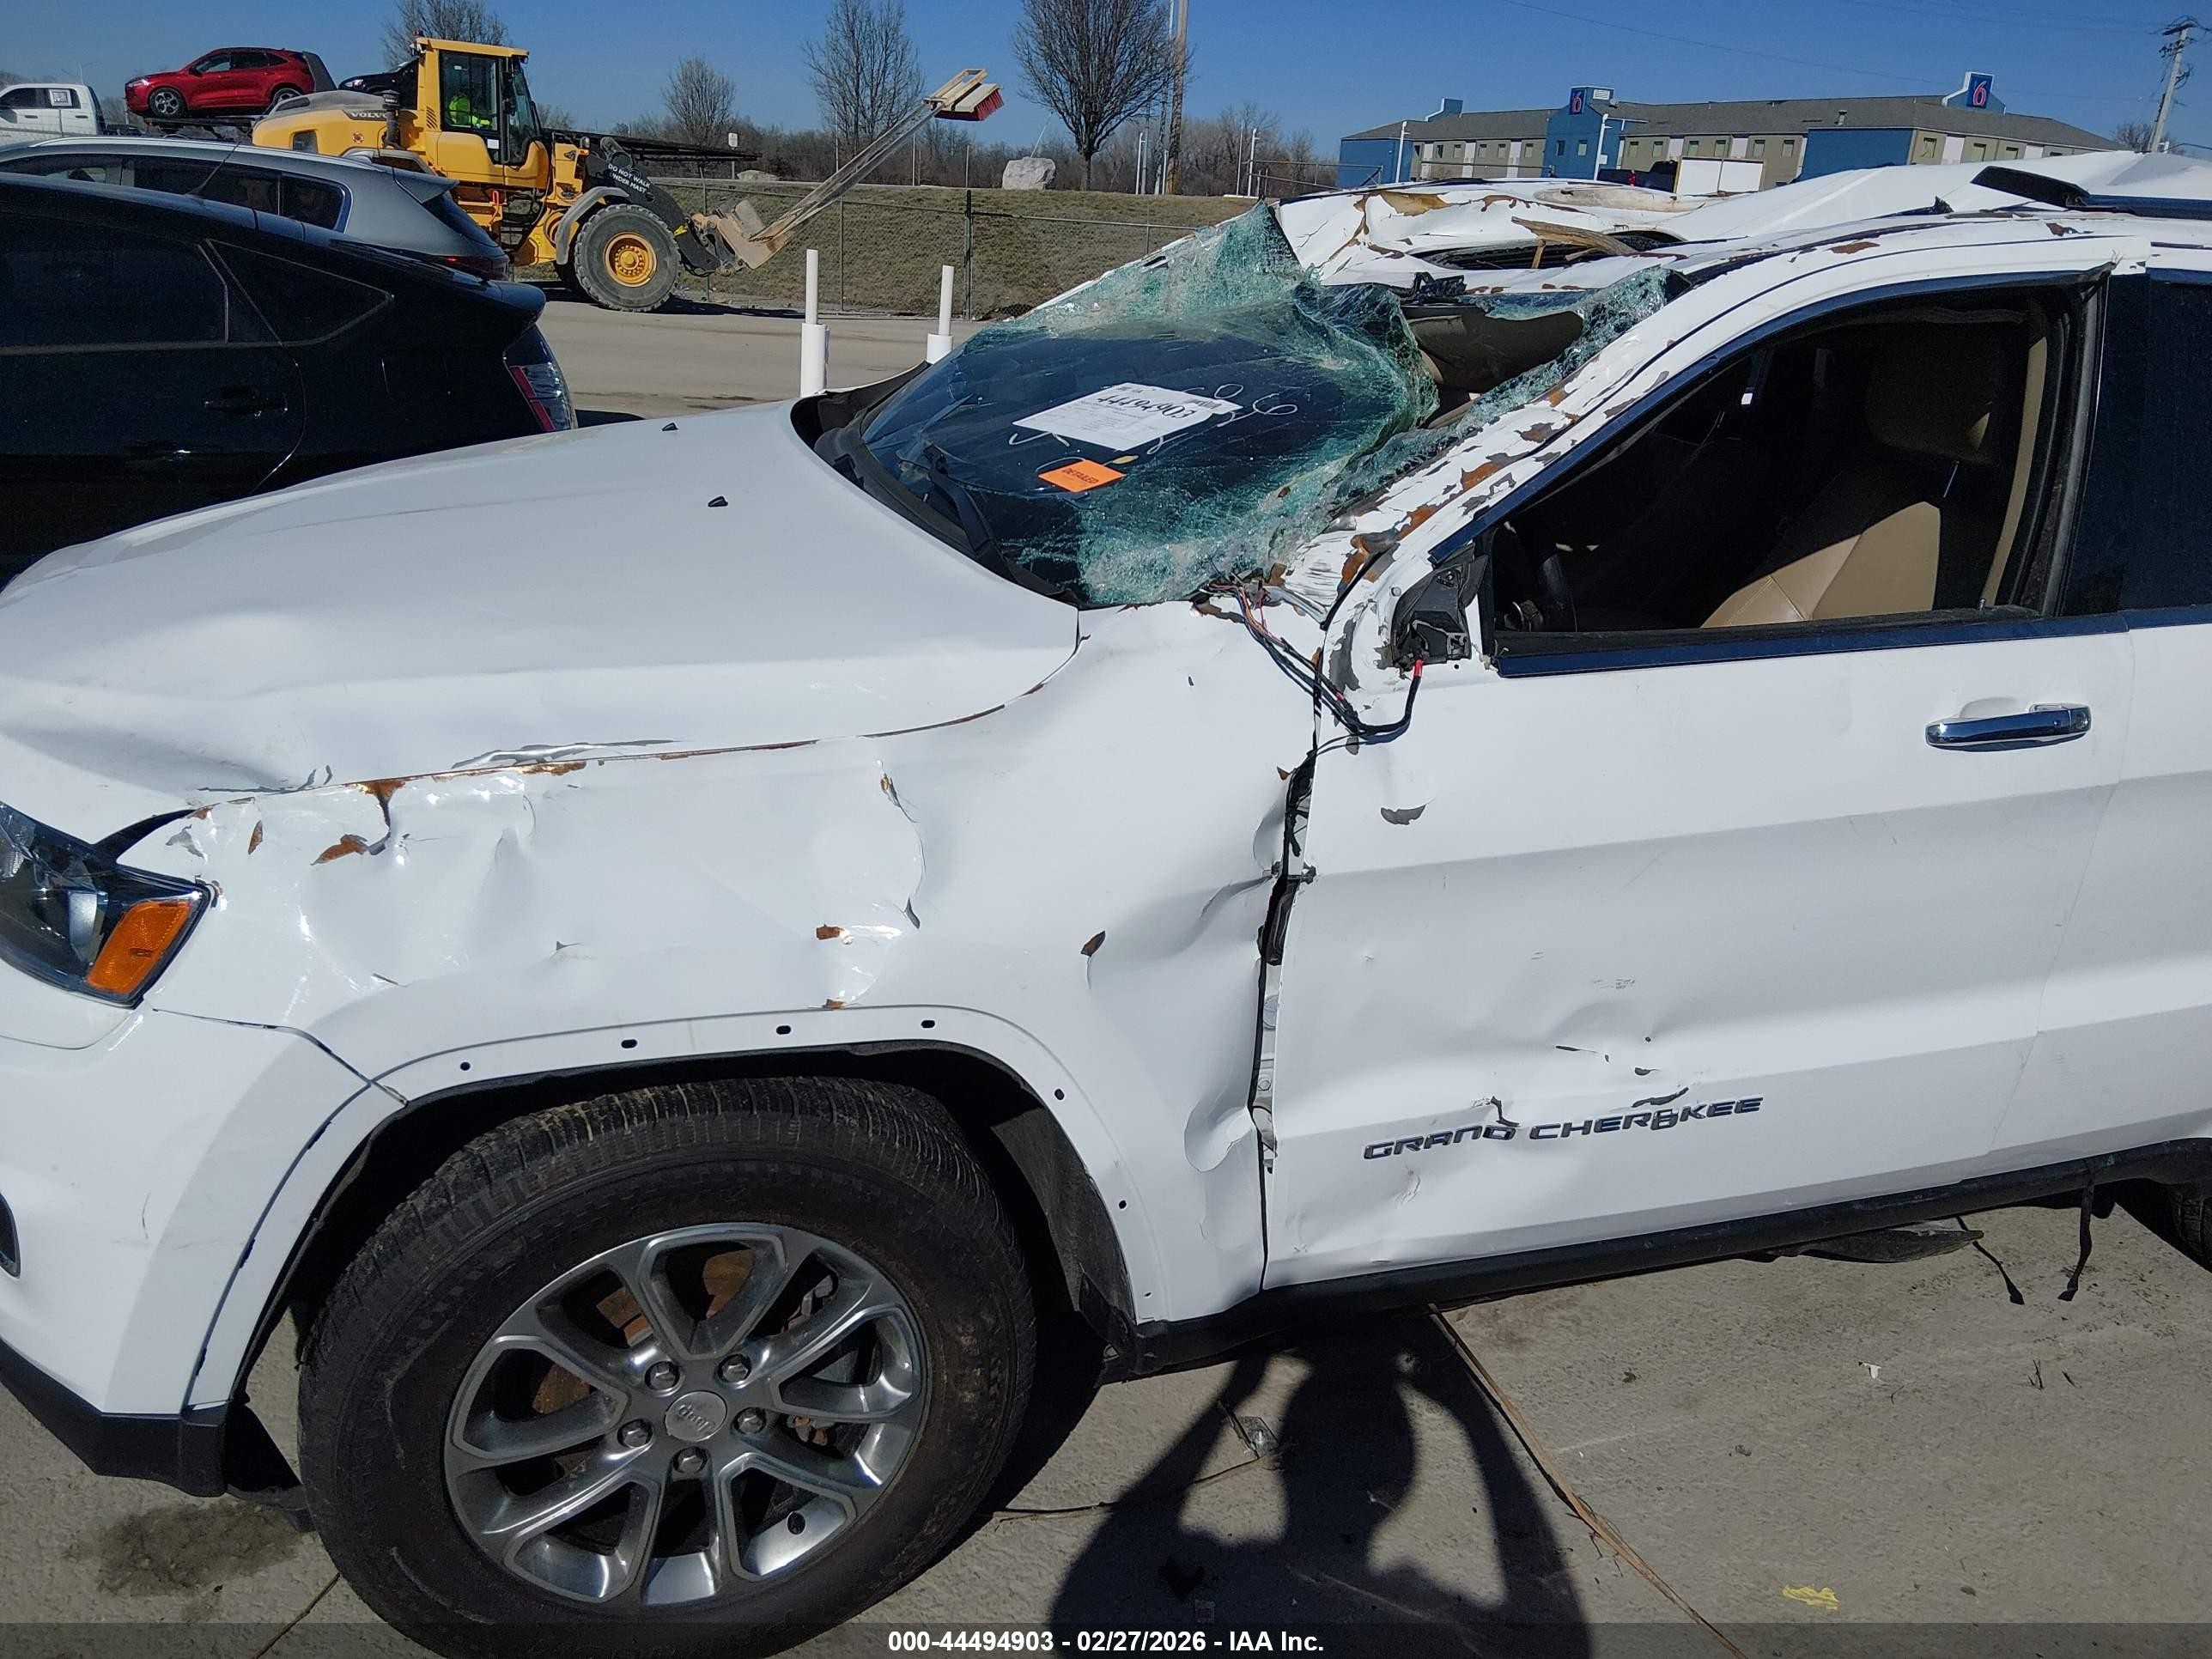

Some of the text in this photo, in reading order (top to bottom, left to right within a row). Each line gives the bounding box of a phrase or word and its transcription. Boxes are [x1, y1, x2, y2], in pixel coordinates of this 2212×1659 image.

[1972, 80, 1987, 106] 6
[608, 163, 651, 188] DO NOT WALK
[1097, 394, 1197, 419] 44494903
[1363, 1096, 1764, 1161] GRAND CHEROKEE
